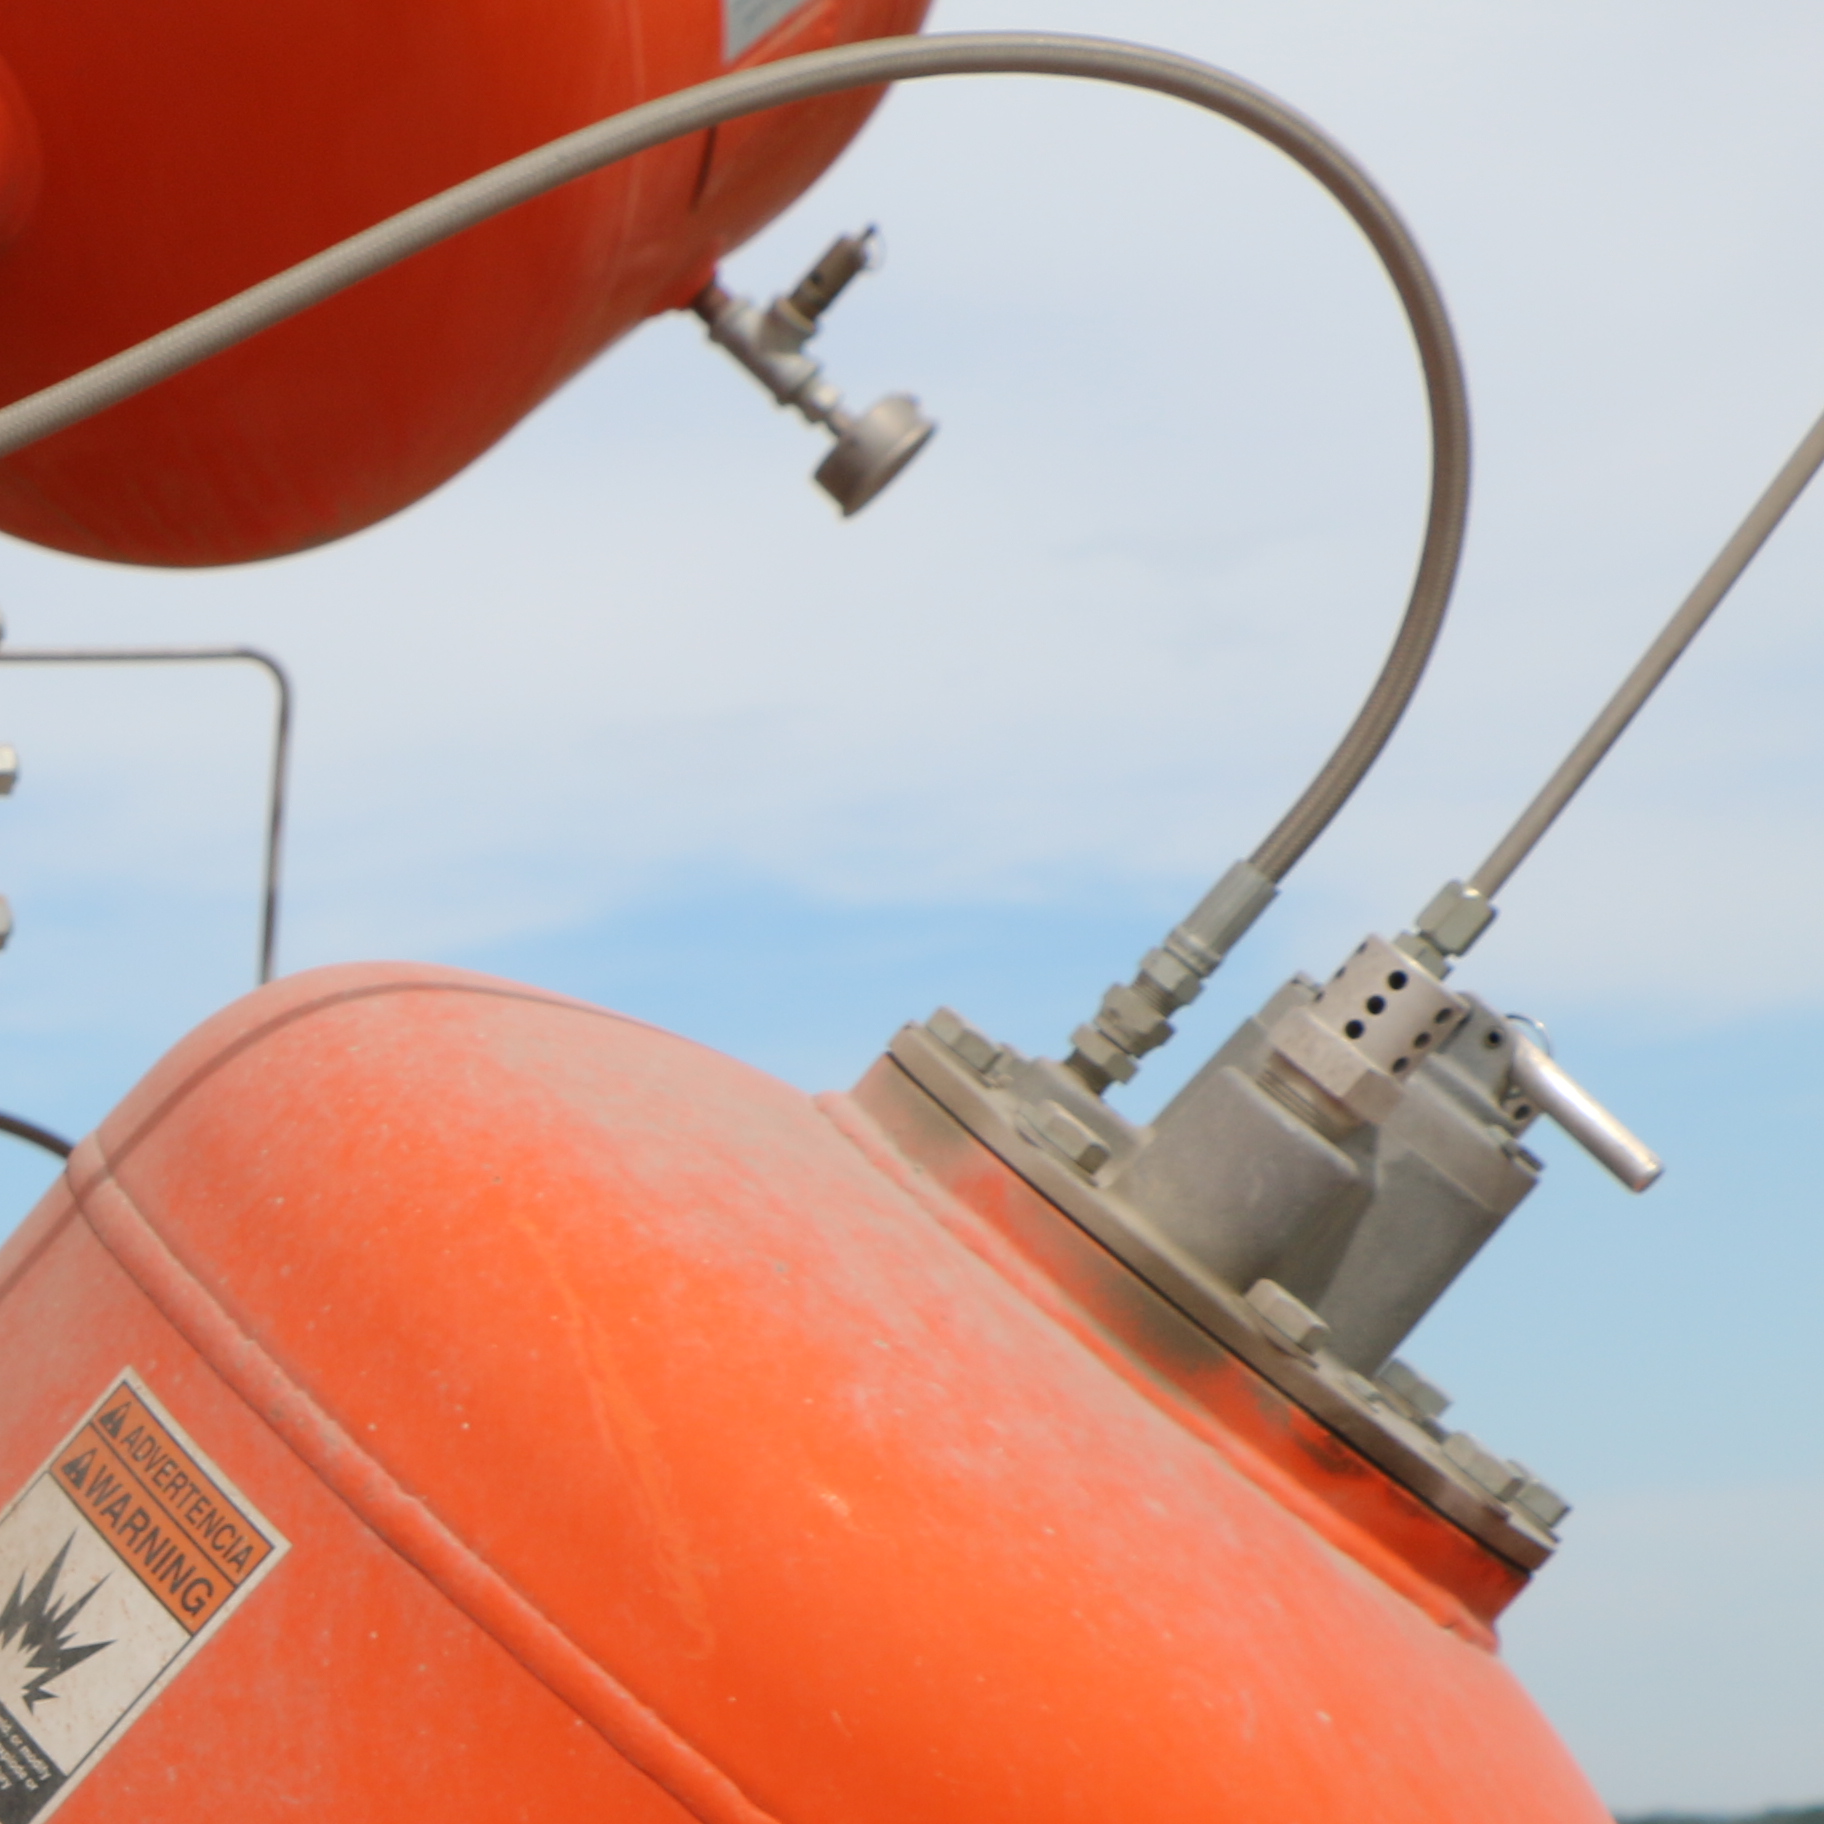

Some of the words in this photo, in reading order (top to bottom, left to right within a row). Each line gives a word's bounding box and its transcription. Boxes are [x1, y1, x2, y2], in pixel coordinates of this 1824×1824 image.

[83, 1464, 212, 1617] WARNING
[120, 1426, 254, 1575] ADVERTENCIA
[8, 1732, 24, 1749] or
[17, 1742, 55, 1783] modify
[23, 1777, 39, 1793] or
